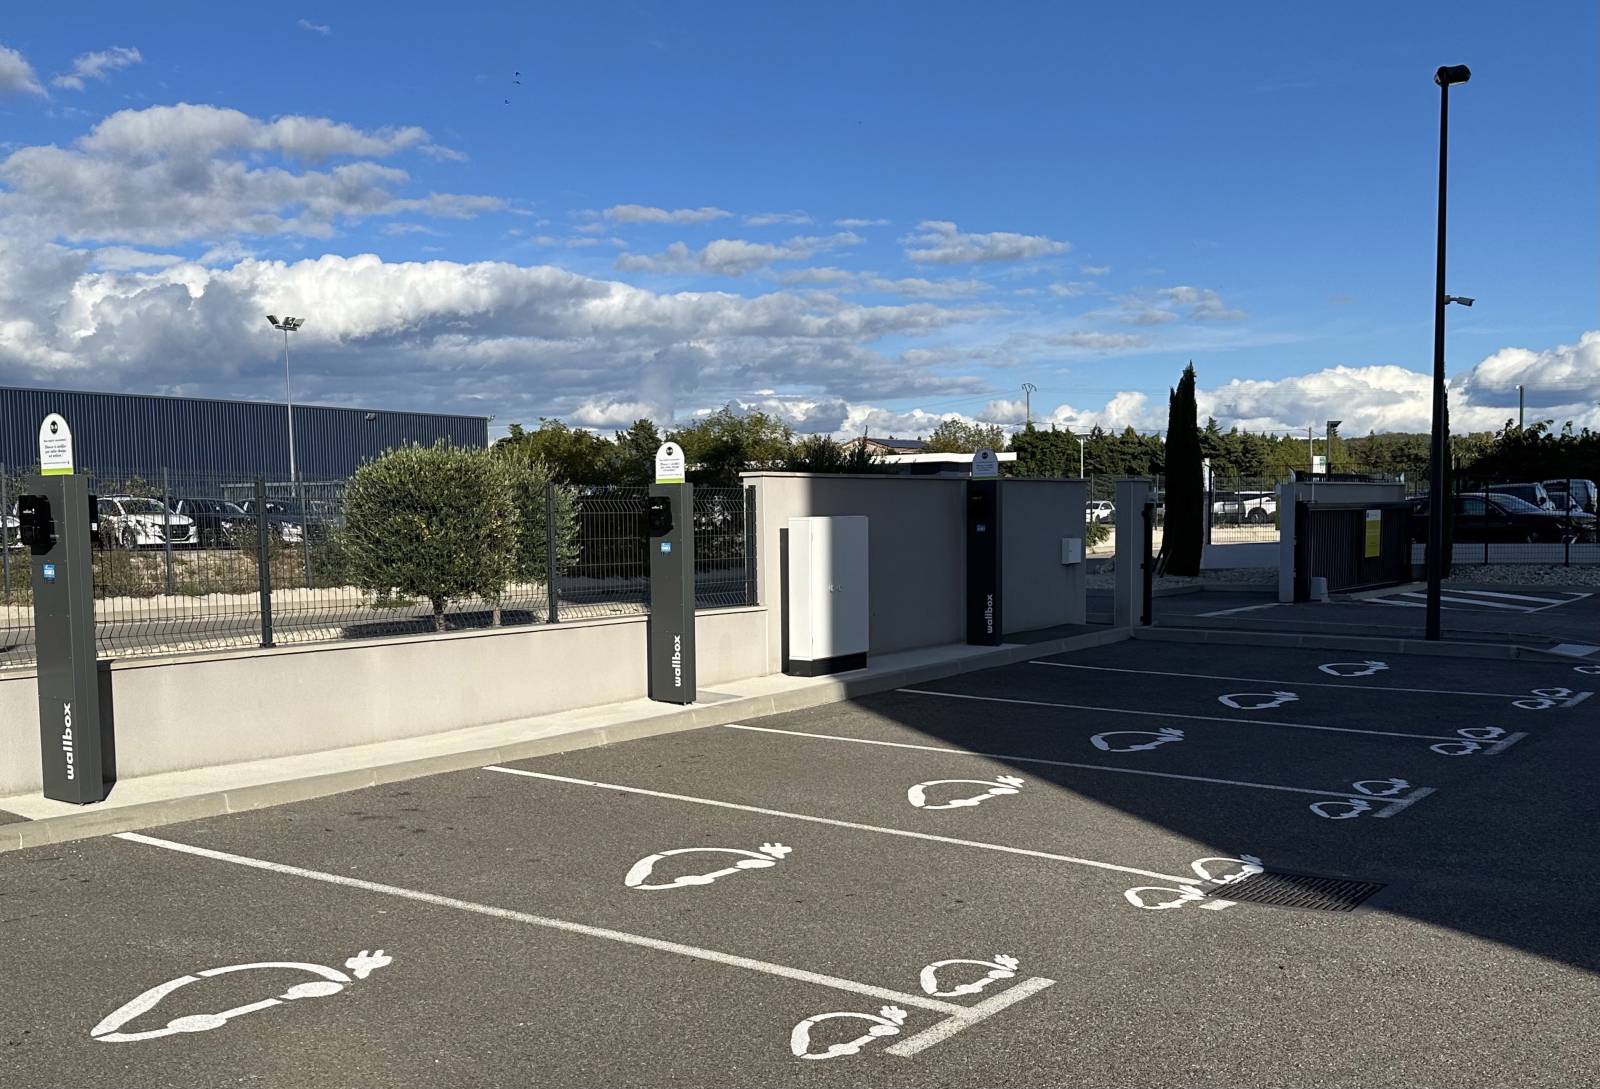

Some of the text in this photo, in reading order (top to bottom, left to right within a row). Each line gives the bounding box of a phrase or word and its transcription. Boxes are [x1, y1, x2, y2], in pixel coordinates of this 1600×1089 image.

[984, 594, 993, 634] wallbox
[672, 634, 682, 687] wallbox
[62, 702, 74, 780] wallbox
